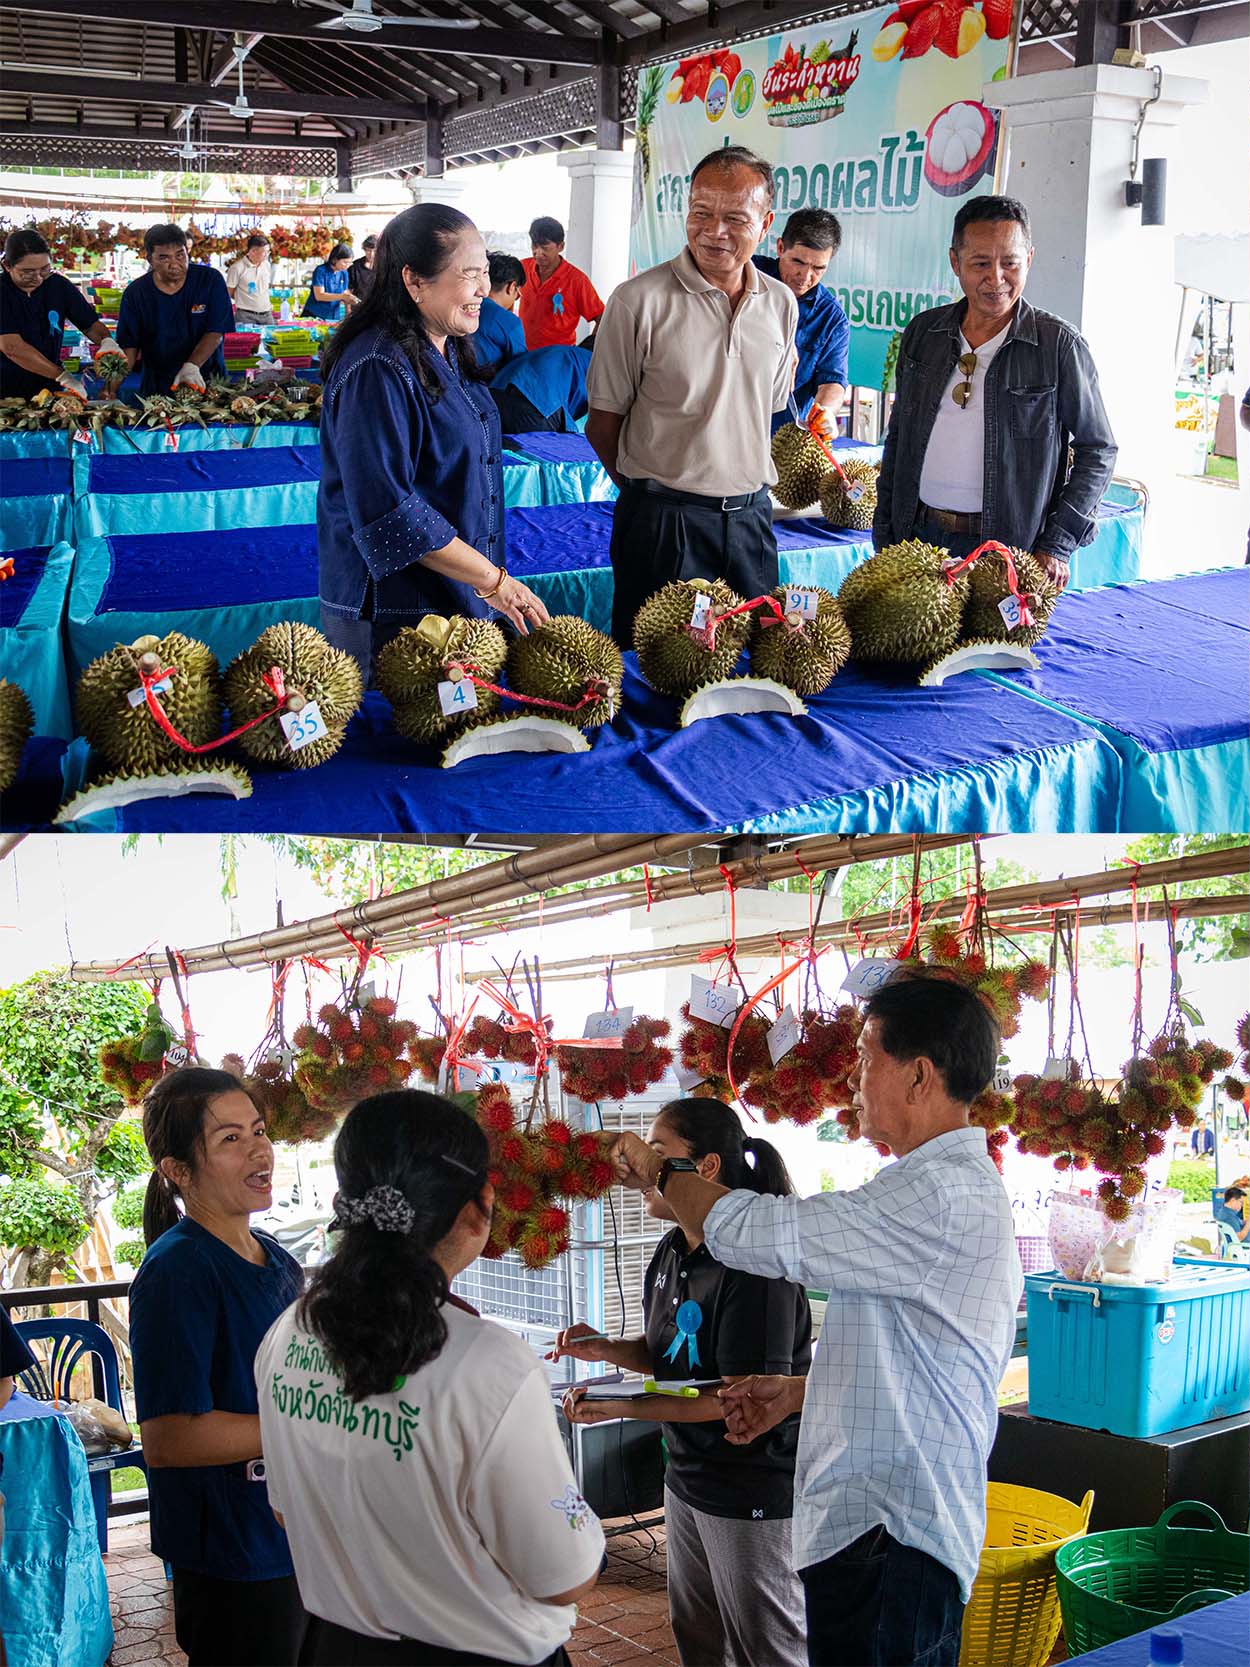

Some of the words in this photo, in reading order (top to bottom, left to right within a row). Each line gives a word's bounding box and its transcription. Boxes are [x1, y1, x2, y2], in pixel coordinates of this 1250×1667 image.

[1002, 601, 1020, 622] 39
[453, 686, 466, 704] 4
[290, 712, 318, 742] 35
[704, 989, 728, 1014] 132
[992, 1077, 1010, 1090] 119
[272, 1373, 421, 1462] จังหวัดจันทบุรี
